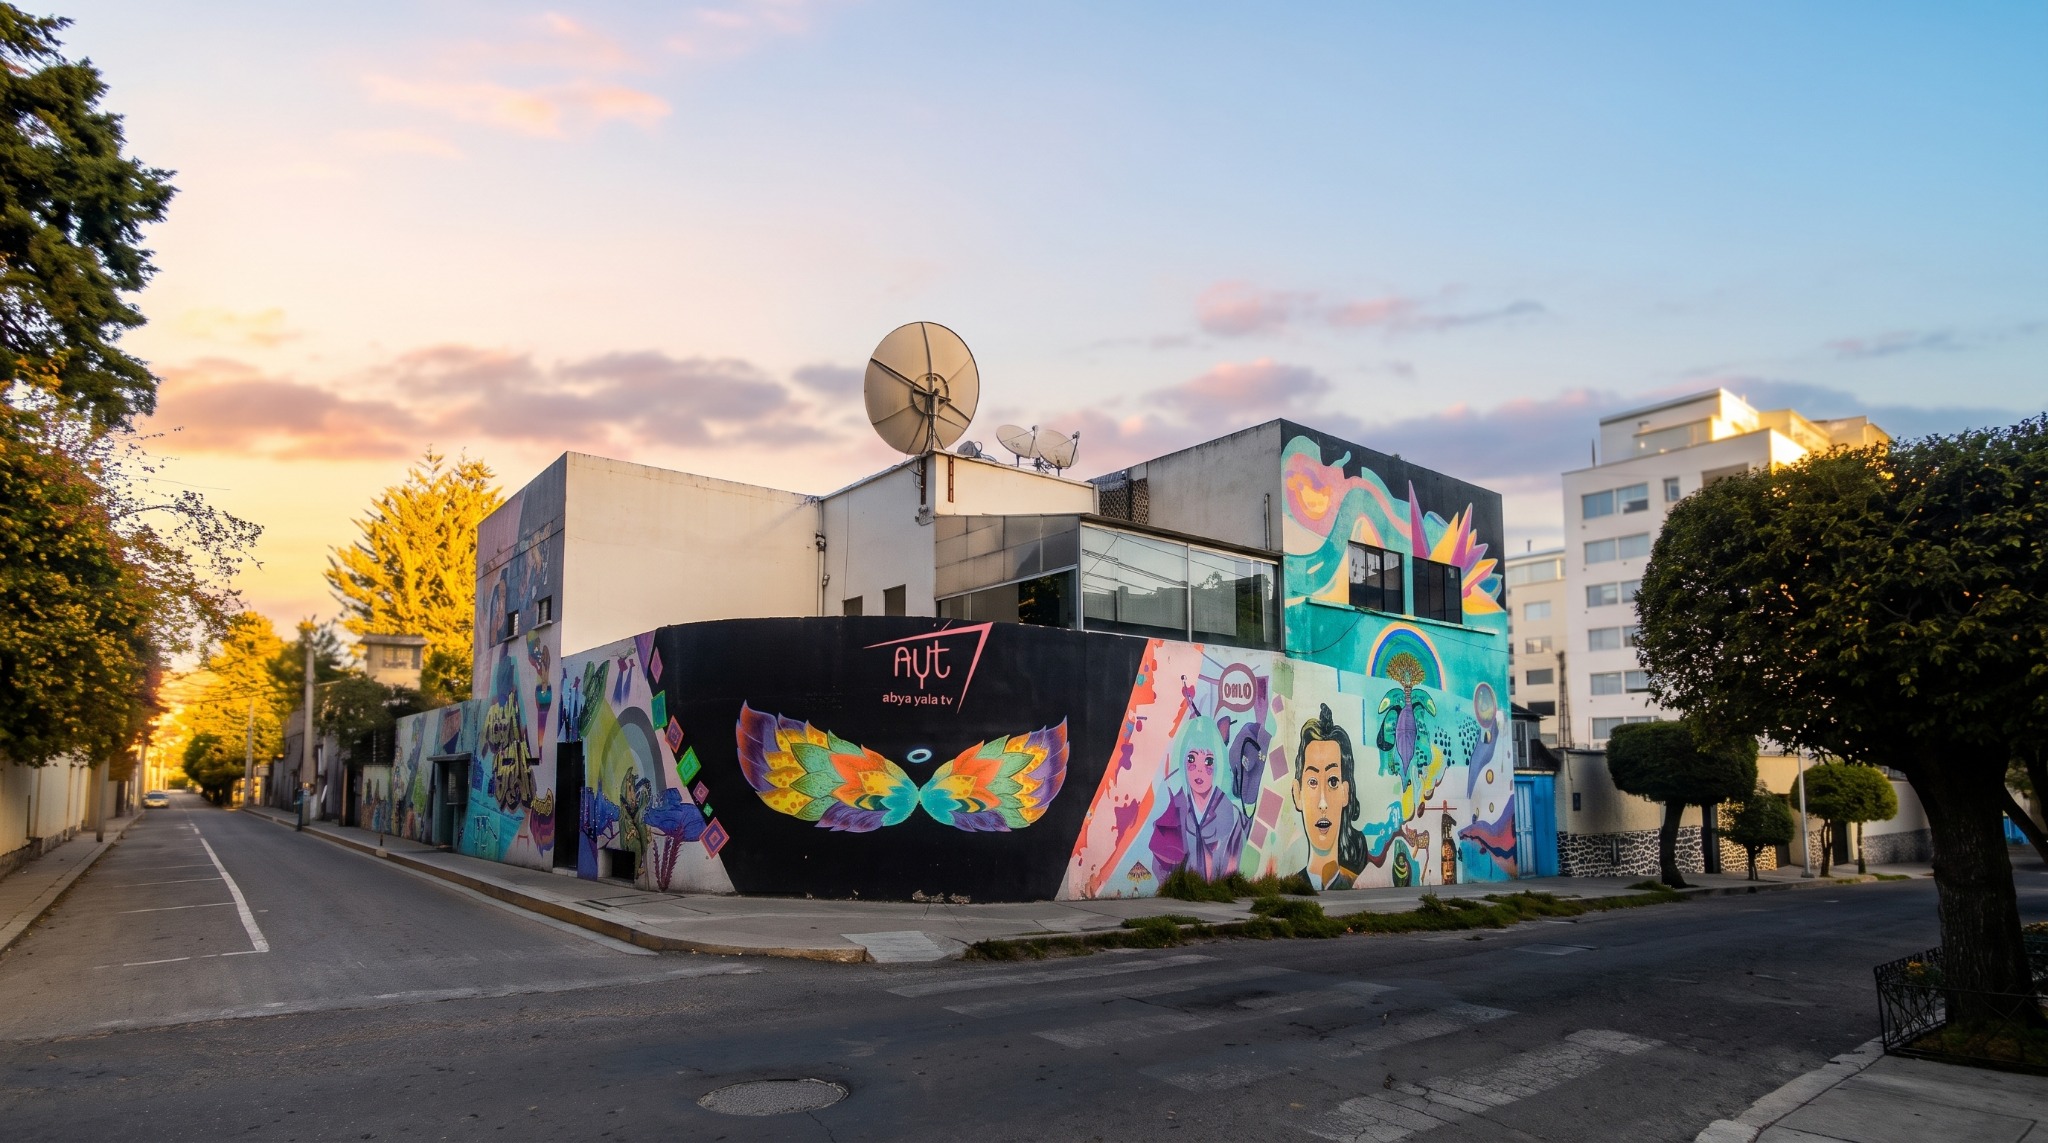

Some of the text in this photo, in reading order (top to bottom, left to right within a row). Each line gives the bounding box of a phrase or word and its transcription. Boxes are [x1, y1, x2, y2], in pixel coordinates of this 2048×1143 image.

[882, 691, 953, 707] abya yala tv
